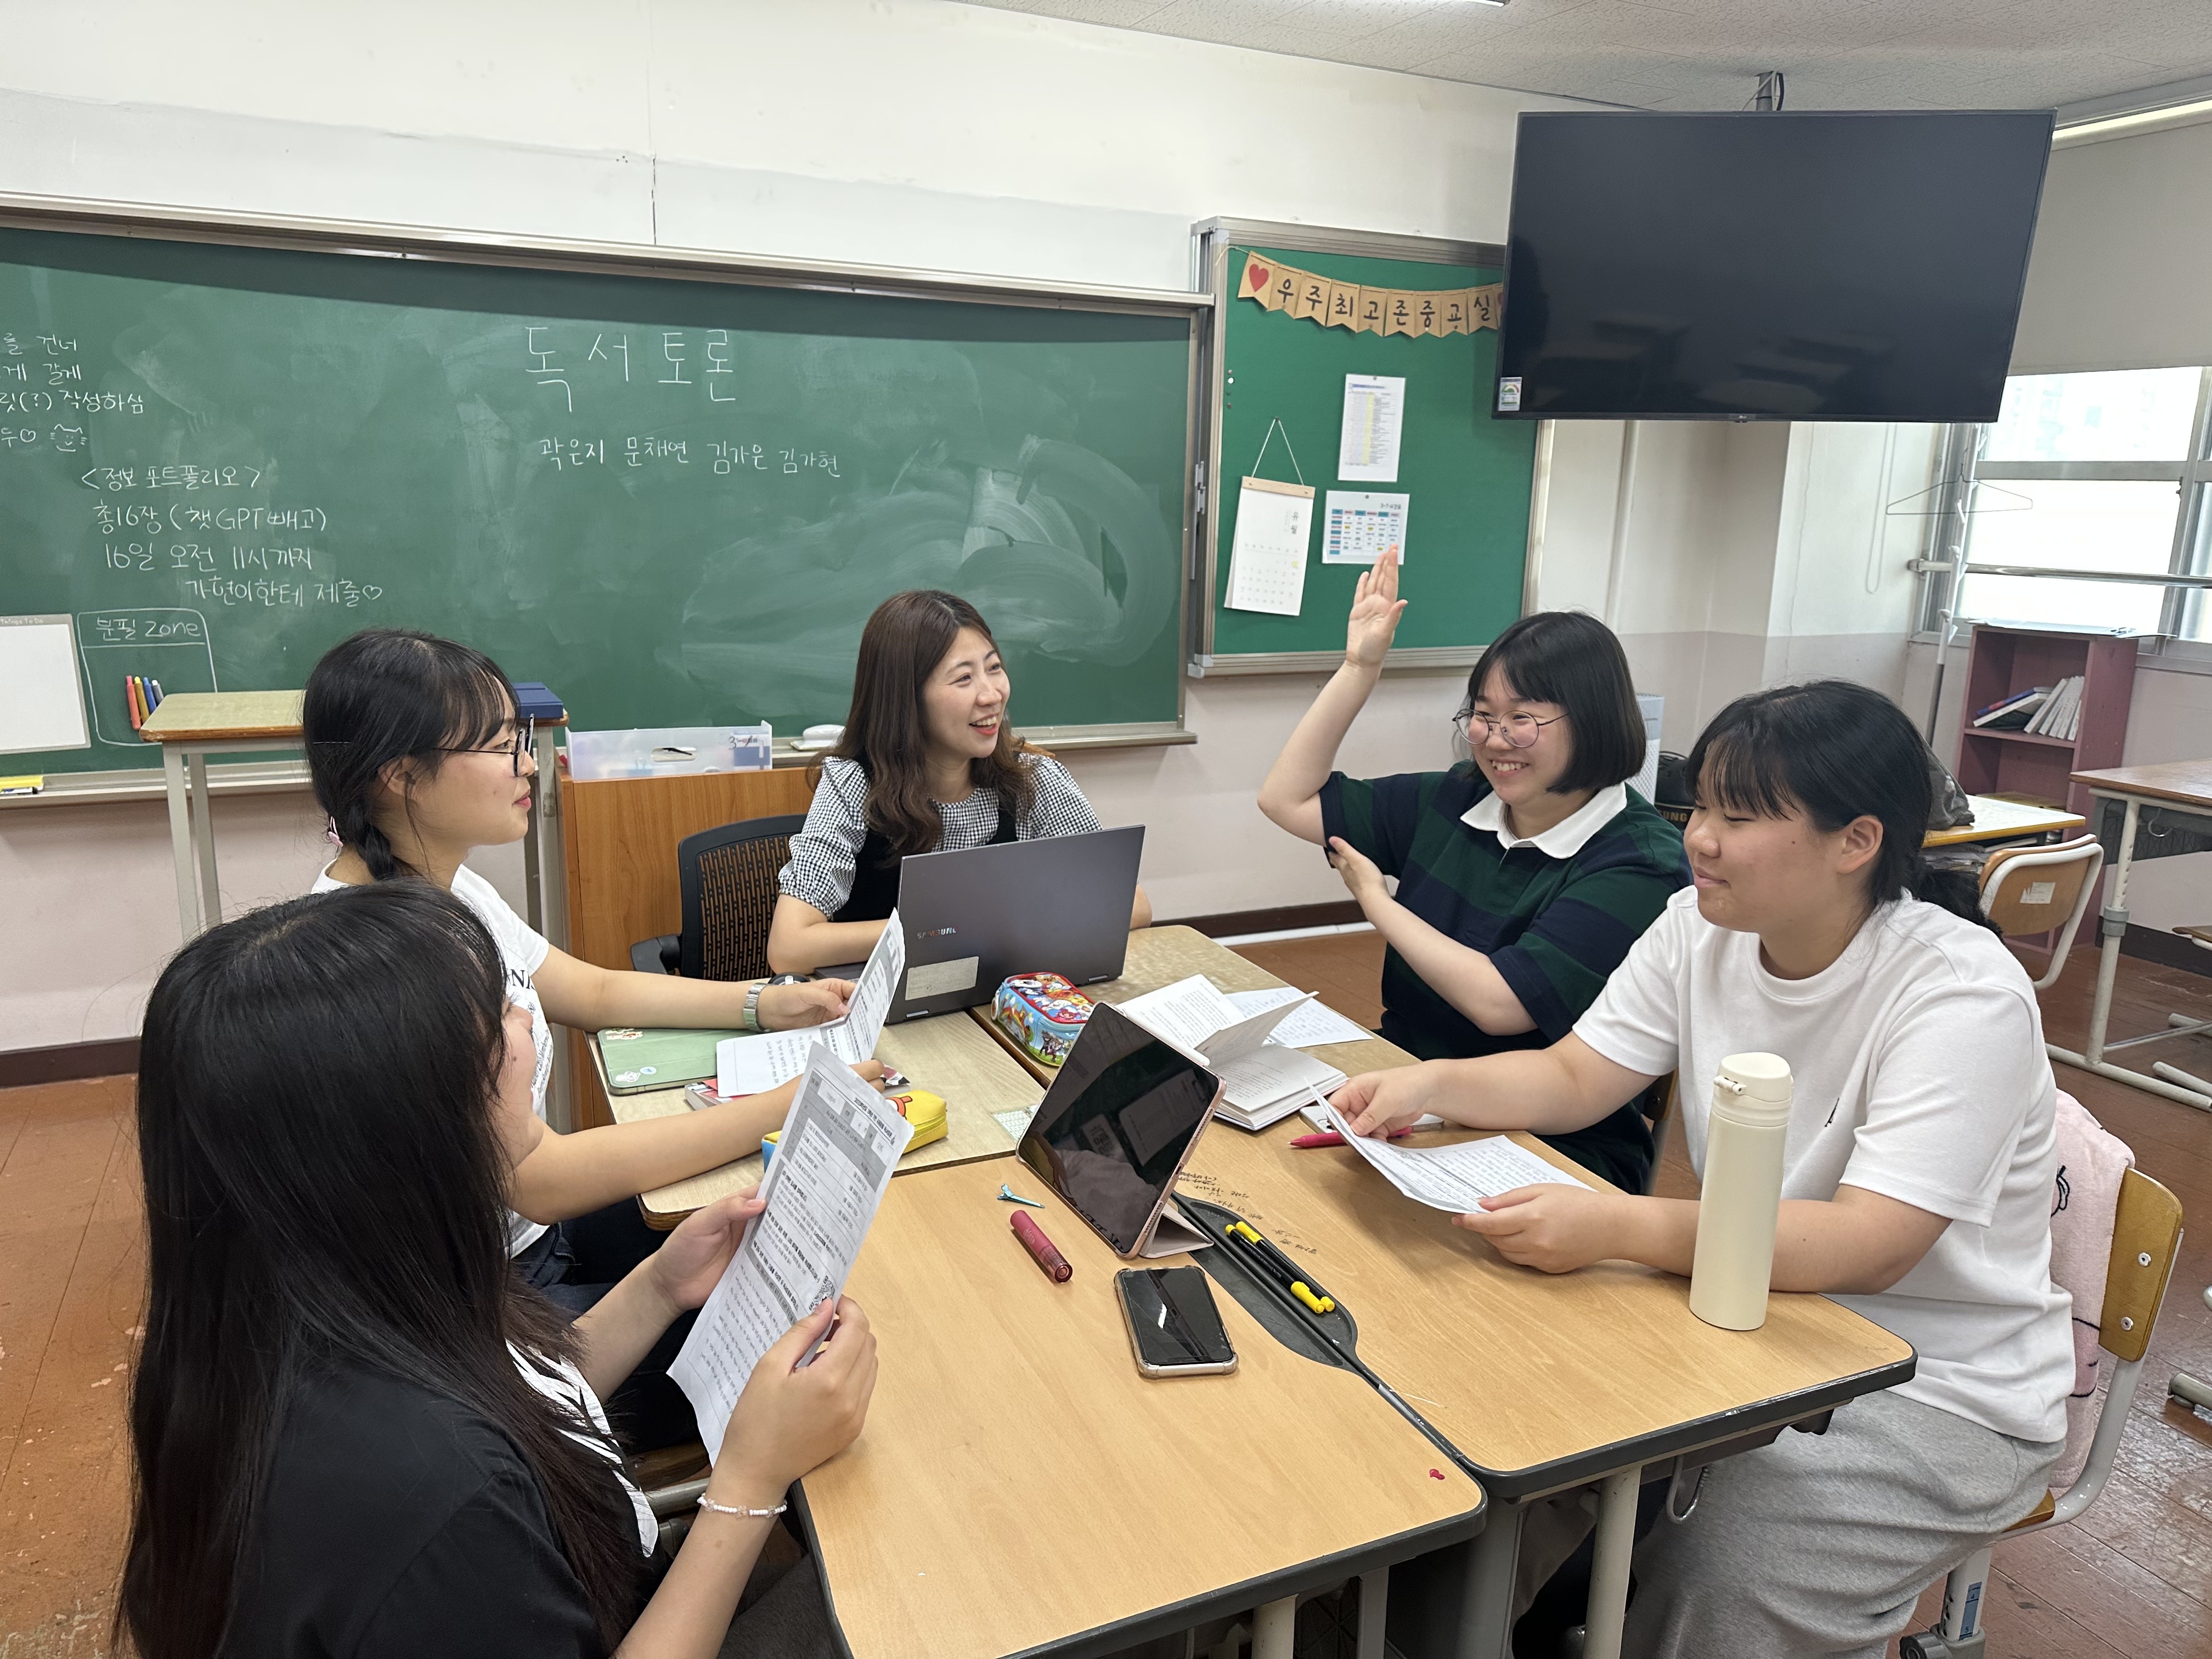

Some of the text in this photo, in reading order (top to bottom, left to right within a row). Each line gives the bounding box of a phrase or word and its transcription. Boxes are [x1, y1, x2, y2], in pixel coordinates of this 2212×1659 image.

[36, 334, 77, 355] 건너
[42, 363, 81, 385] 갈게
[539, 437, 840, 477] 곽은지 문채연 김가은 김가현
[93, 499, 161, 534] 총16장
[106, 543, 154, 571] 16일
[171, 544, 217, 572] 오전
[185, 575, 303, 607] 가현이한테
[96, 617, 136, 641] 분필
